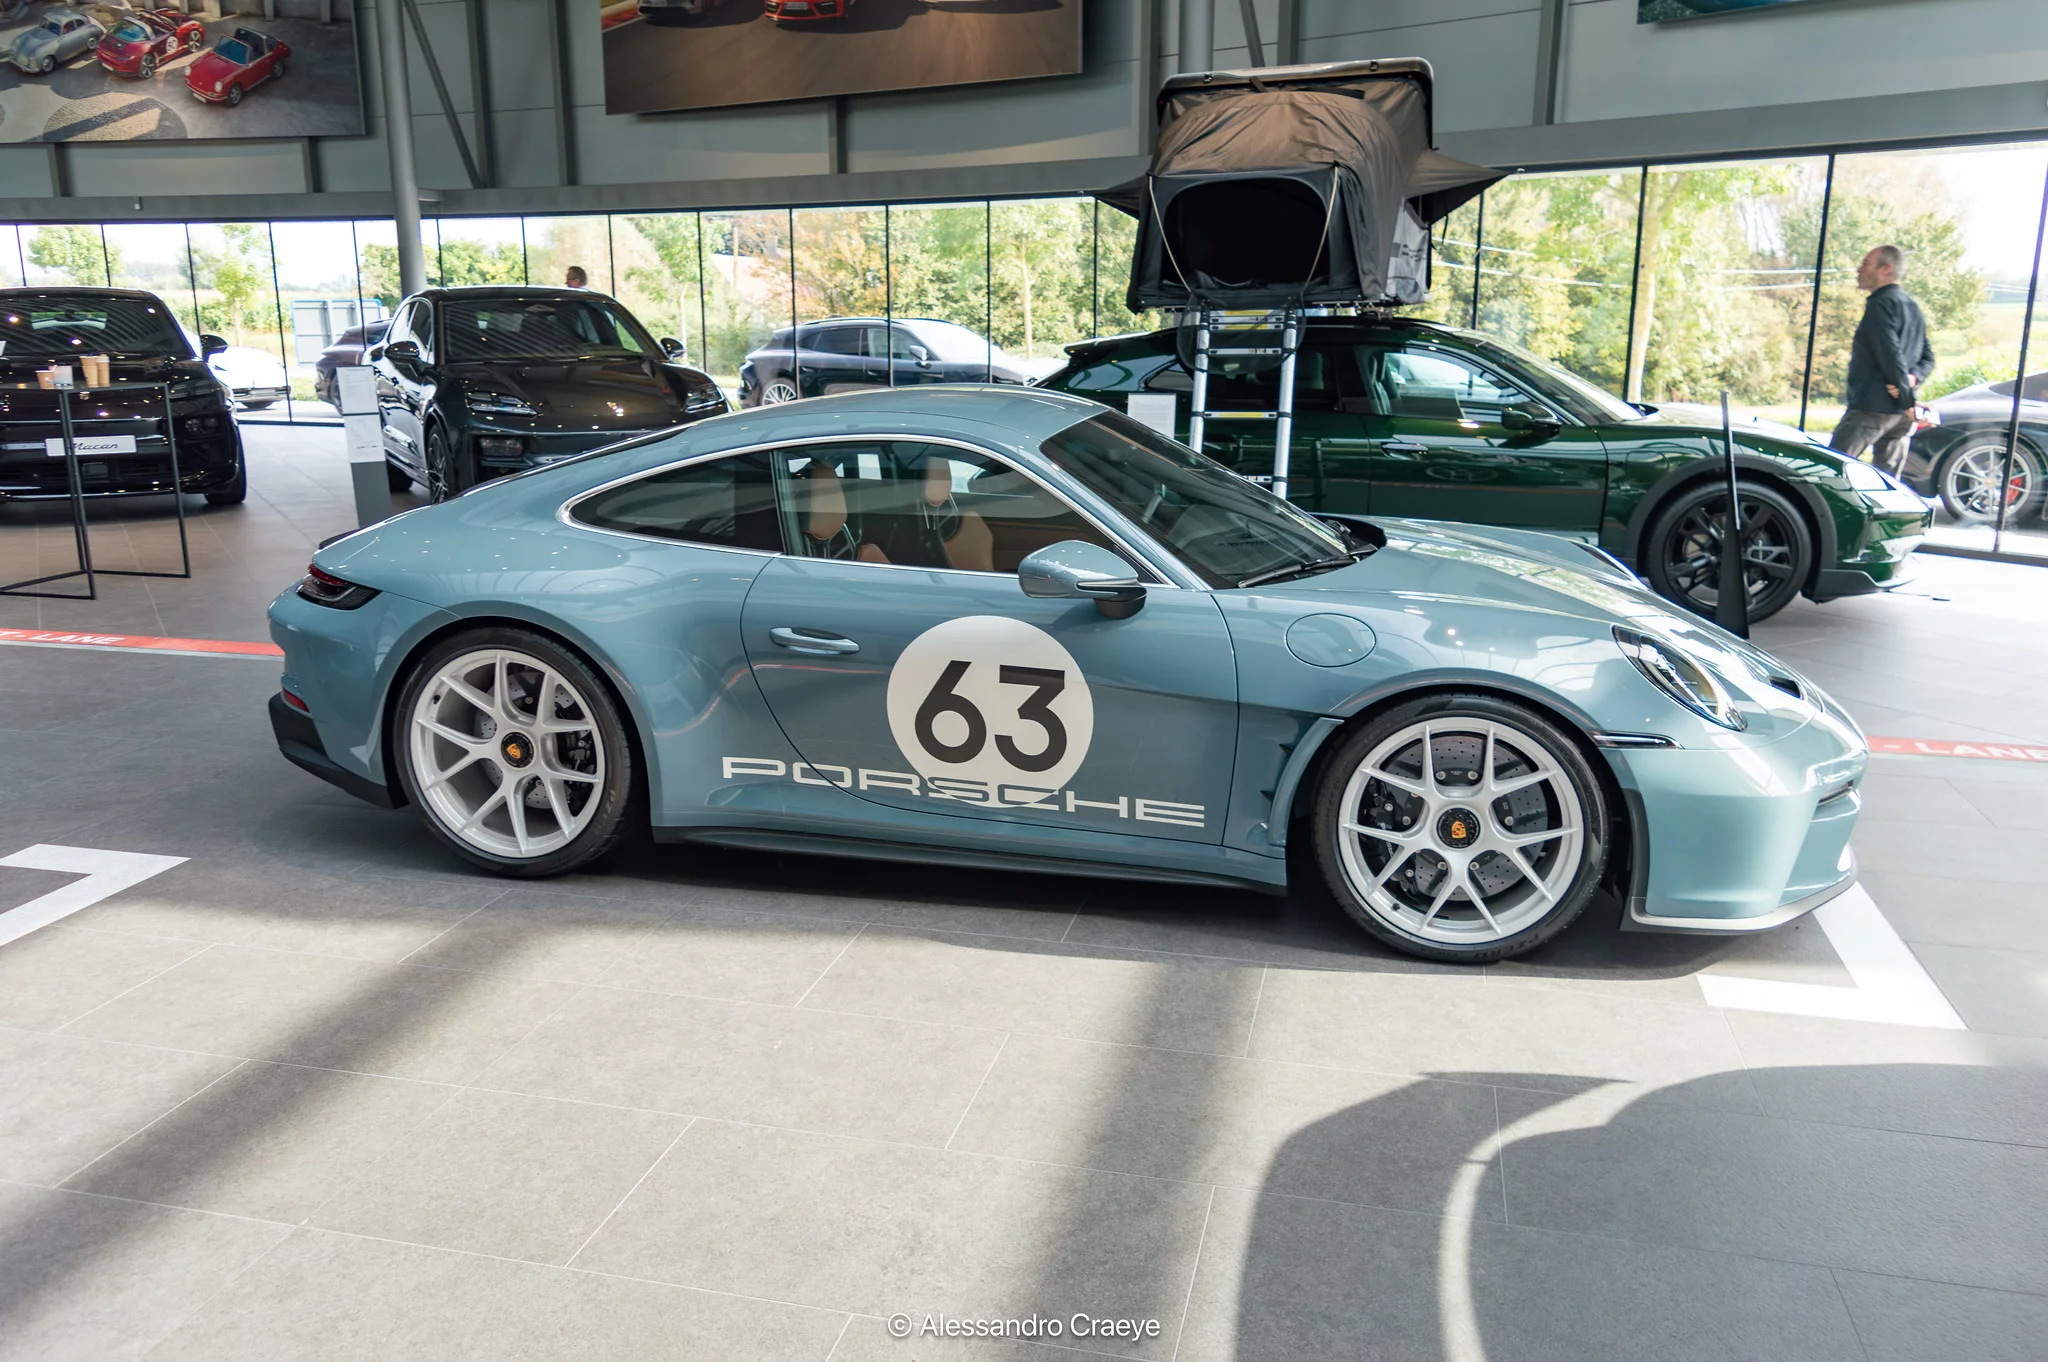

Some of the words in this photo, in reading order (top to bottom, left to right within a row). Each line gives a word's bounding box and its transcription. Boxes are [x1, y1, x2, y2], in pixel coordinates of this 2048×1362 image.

[29, 633, 126, 645] LANE
[914, 659, 1068, 773] 63
[721, 756, 1205, 828] PORSCHE
